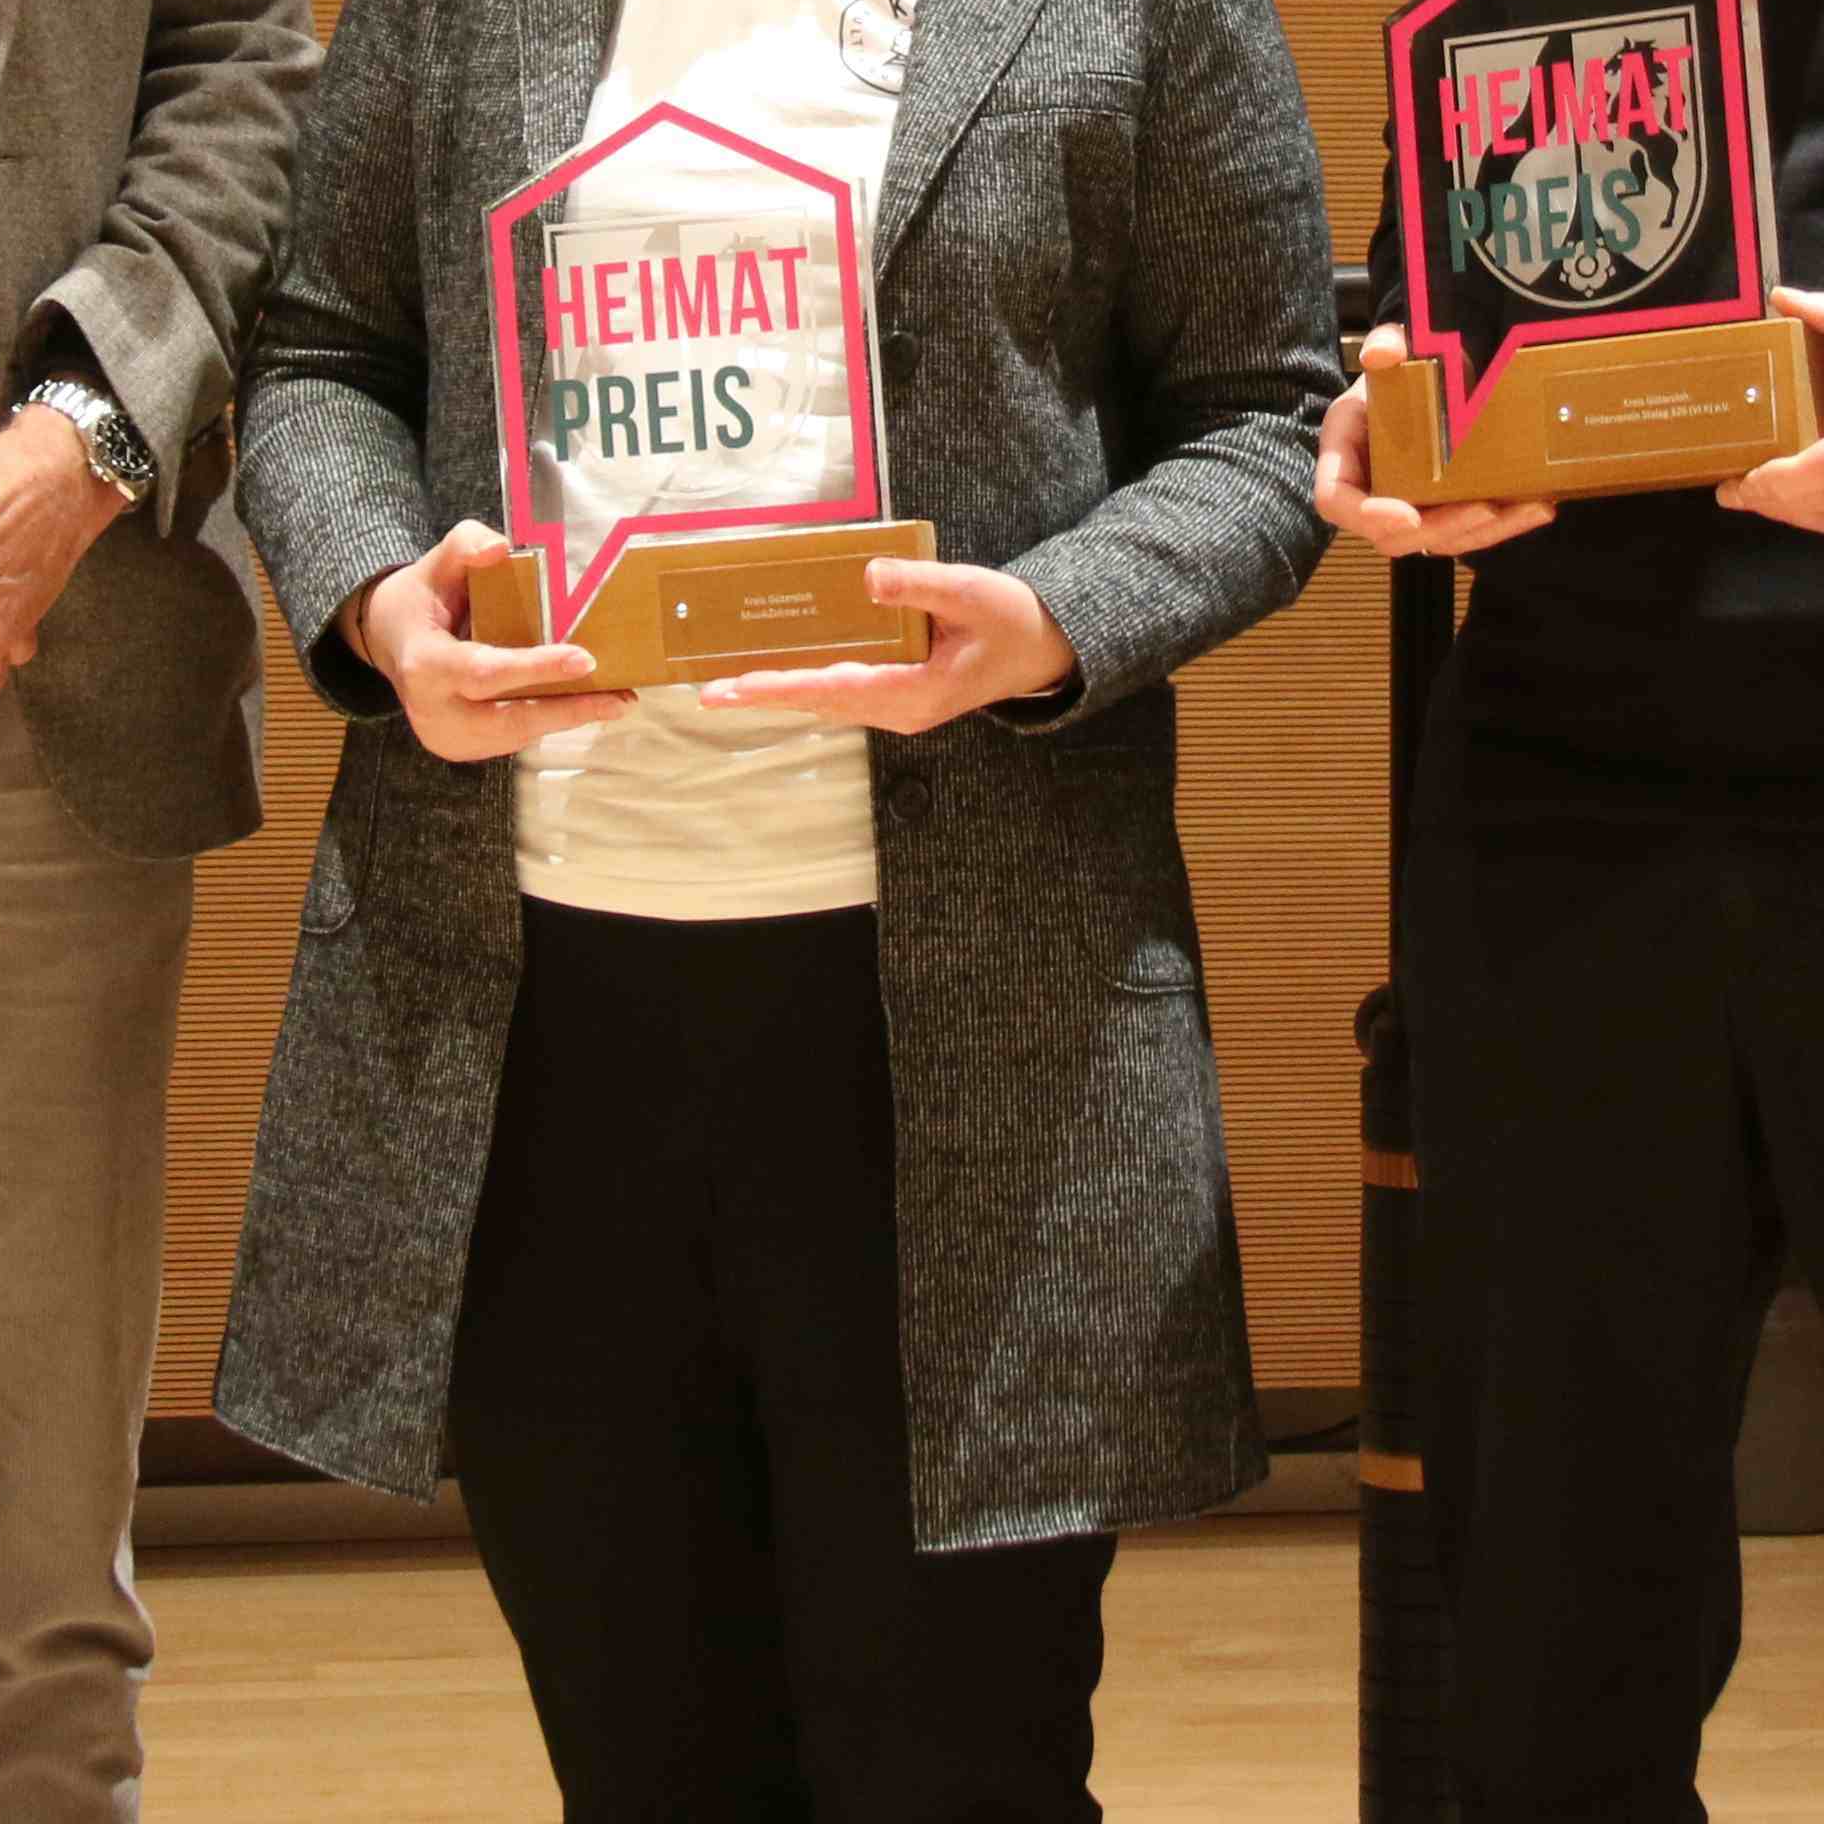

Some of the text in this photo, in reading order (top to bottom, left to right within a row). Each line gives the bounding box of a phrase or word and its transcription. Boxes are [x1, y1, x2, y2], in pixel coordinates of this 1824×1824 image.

[1439, 44, 1693, 161] HEIMAT
[1447, 169, 1641, 273] PREIS
[542, 246, 808, 350] HEIMAT
[550, 365, 754, 462] PREIS
